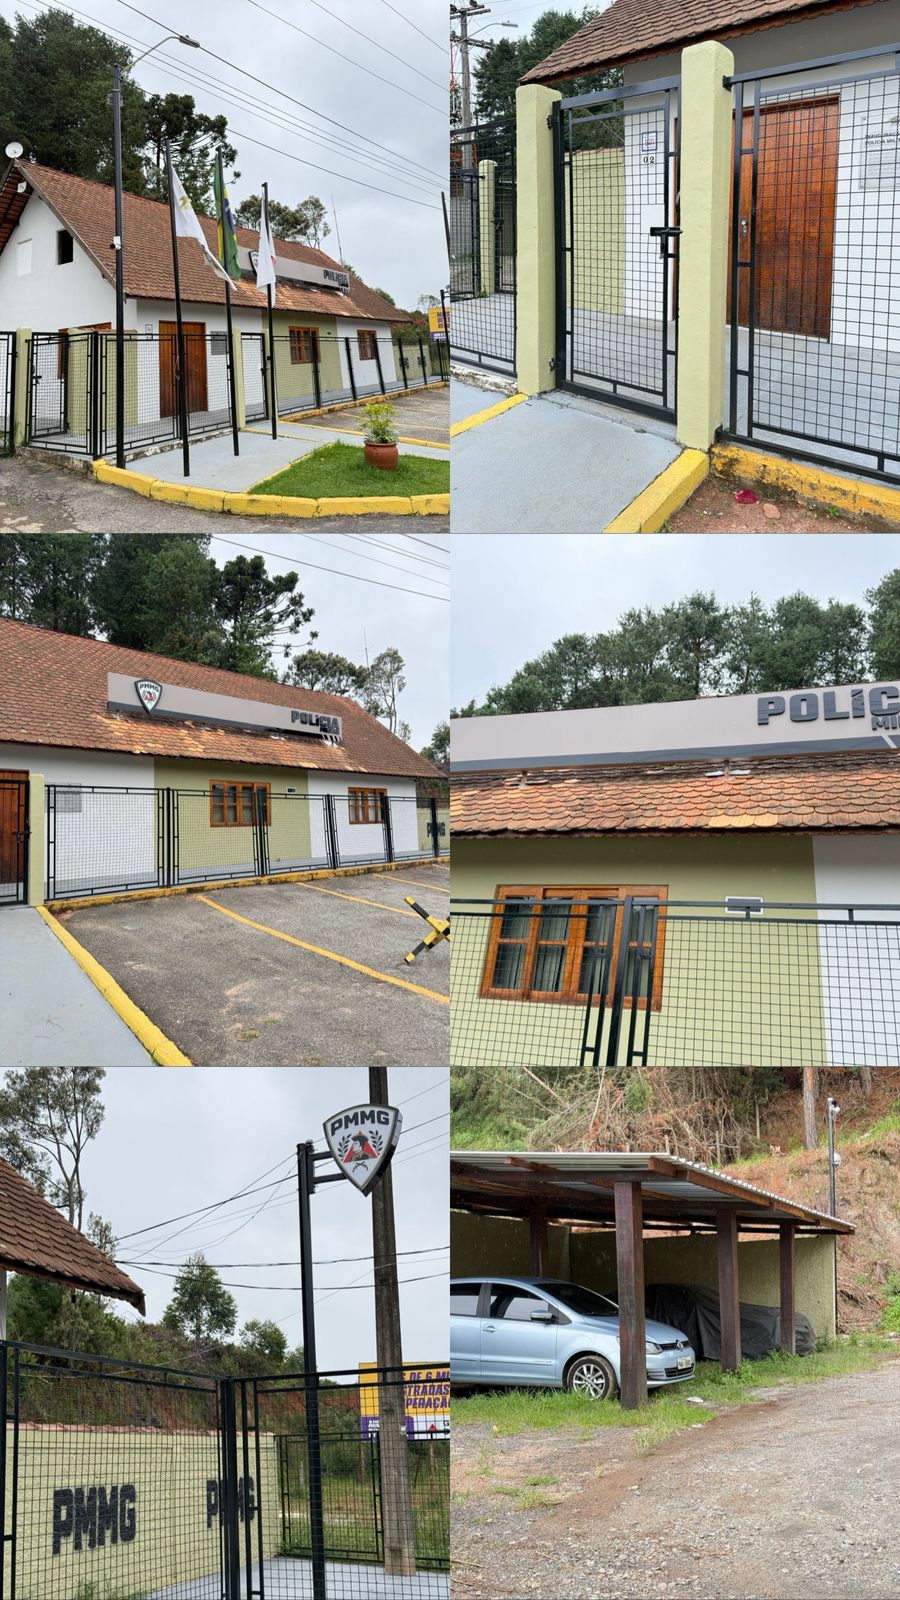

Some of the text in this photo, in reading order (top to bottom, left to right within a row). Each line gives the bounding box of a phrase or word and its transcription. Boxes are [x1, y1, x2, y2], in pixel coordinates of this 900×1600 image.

[643, 156, 655, 164] 02
[139, 683, 160, 692] PMMG
[330, 1109, 389, 1137] PMMG
[52, 1484, 136, 1555] PMMG
